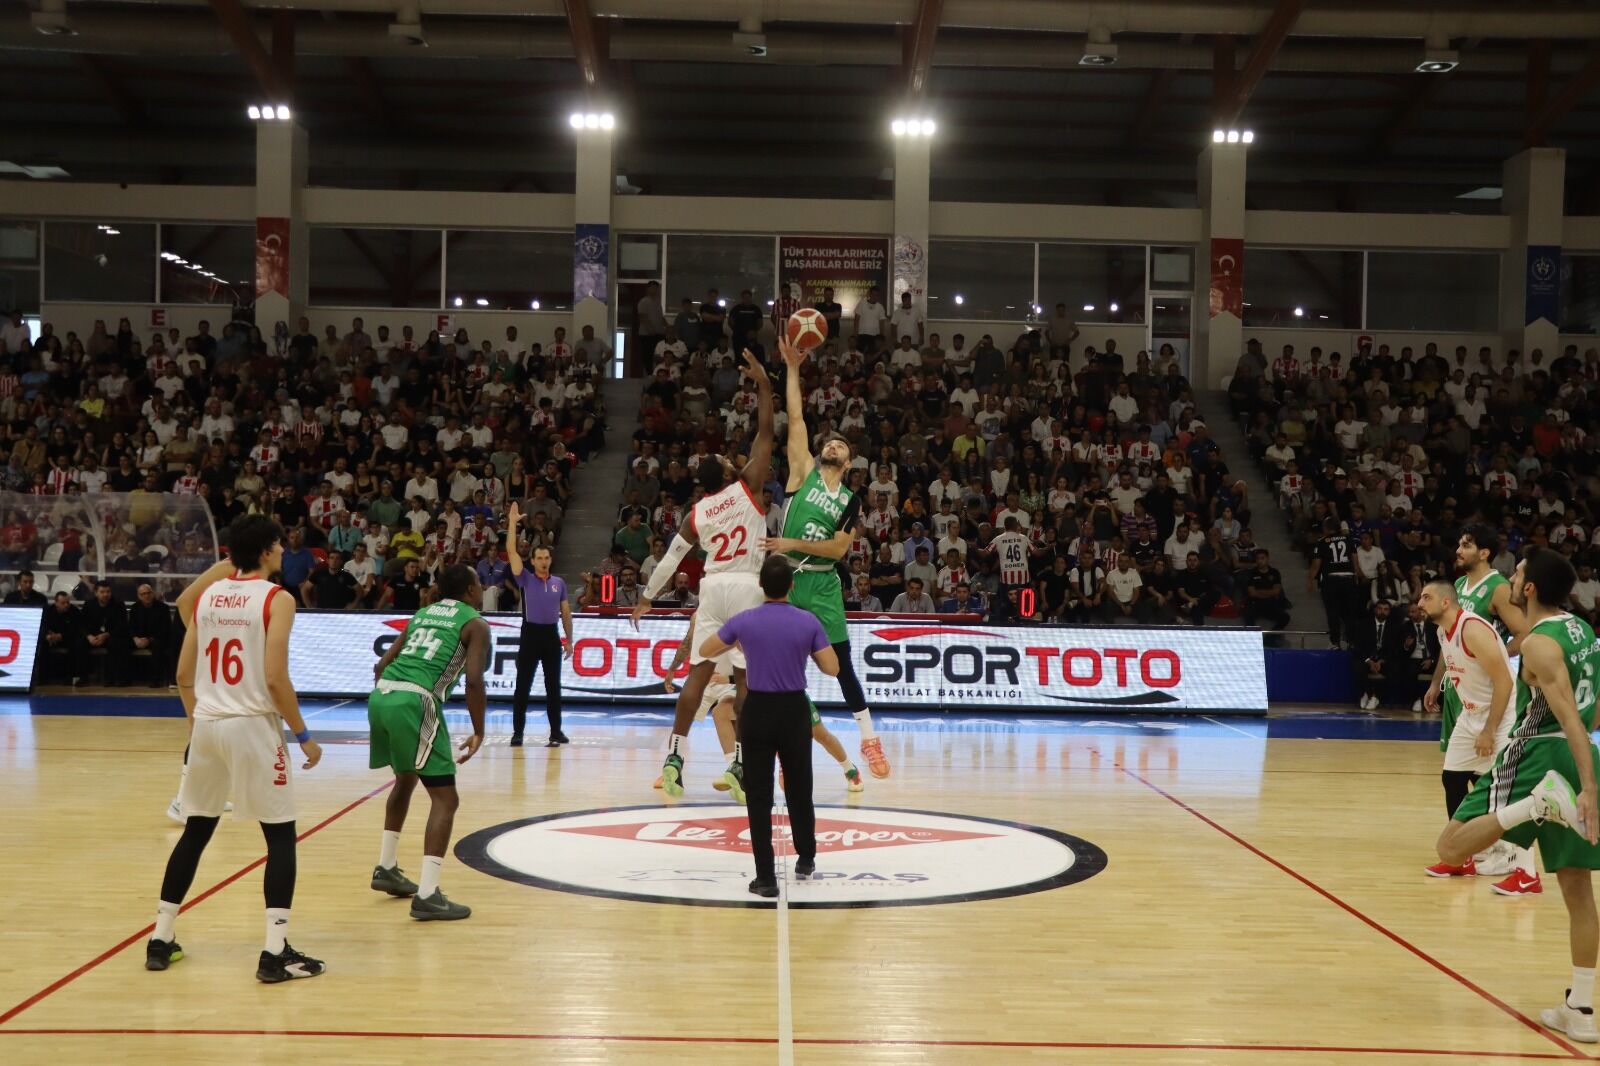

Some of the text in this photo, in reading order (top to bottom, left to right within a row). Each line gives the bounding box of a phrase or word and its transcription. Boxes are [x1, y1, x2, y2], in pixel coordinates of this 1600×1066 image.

[783, 246, 885, 258] TÜM TAKIMLARIMIZA
[785, 259, 882, 270] BAŞARILAR DİLERİZ
[151, 309, 165, 326] E
[437, 315, 449, 331] F
[705, 496, 737, 519] MORSE
[711, 525, 748, 562] 22
[1006, 543, 1021, 562] 46
[1329, 540, 1349, 563] 12
[601, 574, 615, 603] 0
[209, 593, 252, 609] YENİAY
[426, 605, 459, 617] BROWN
[1021, 588, 1035, 617] 0
[400, 627, 442, 661] 94
[206, 637, 244, 686] 16
[562, 637, 690, 679] OTO
[867, 687, 1022, 699] TEŞKİLAT BAŞKANLIĞI
[635, 822, 728, 842] Lee
